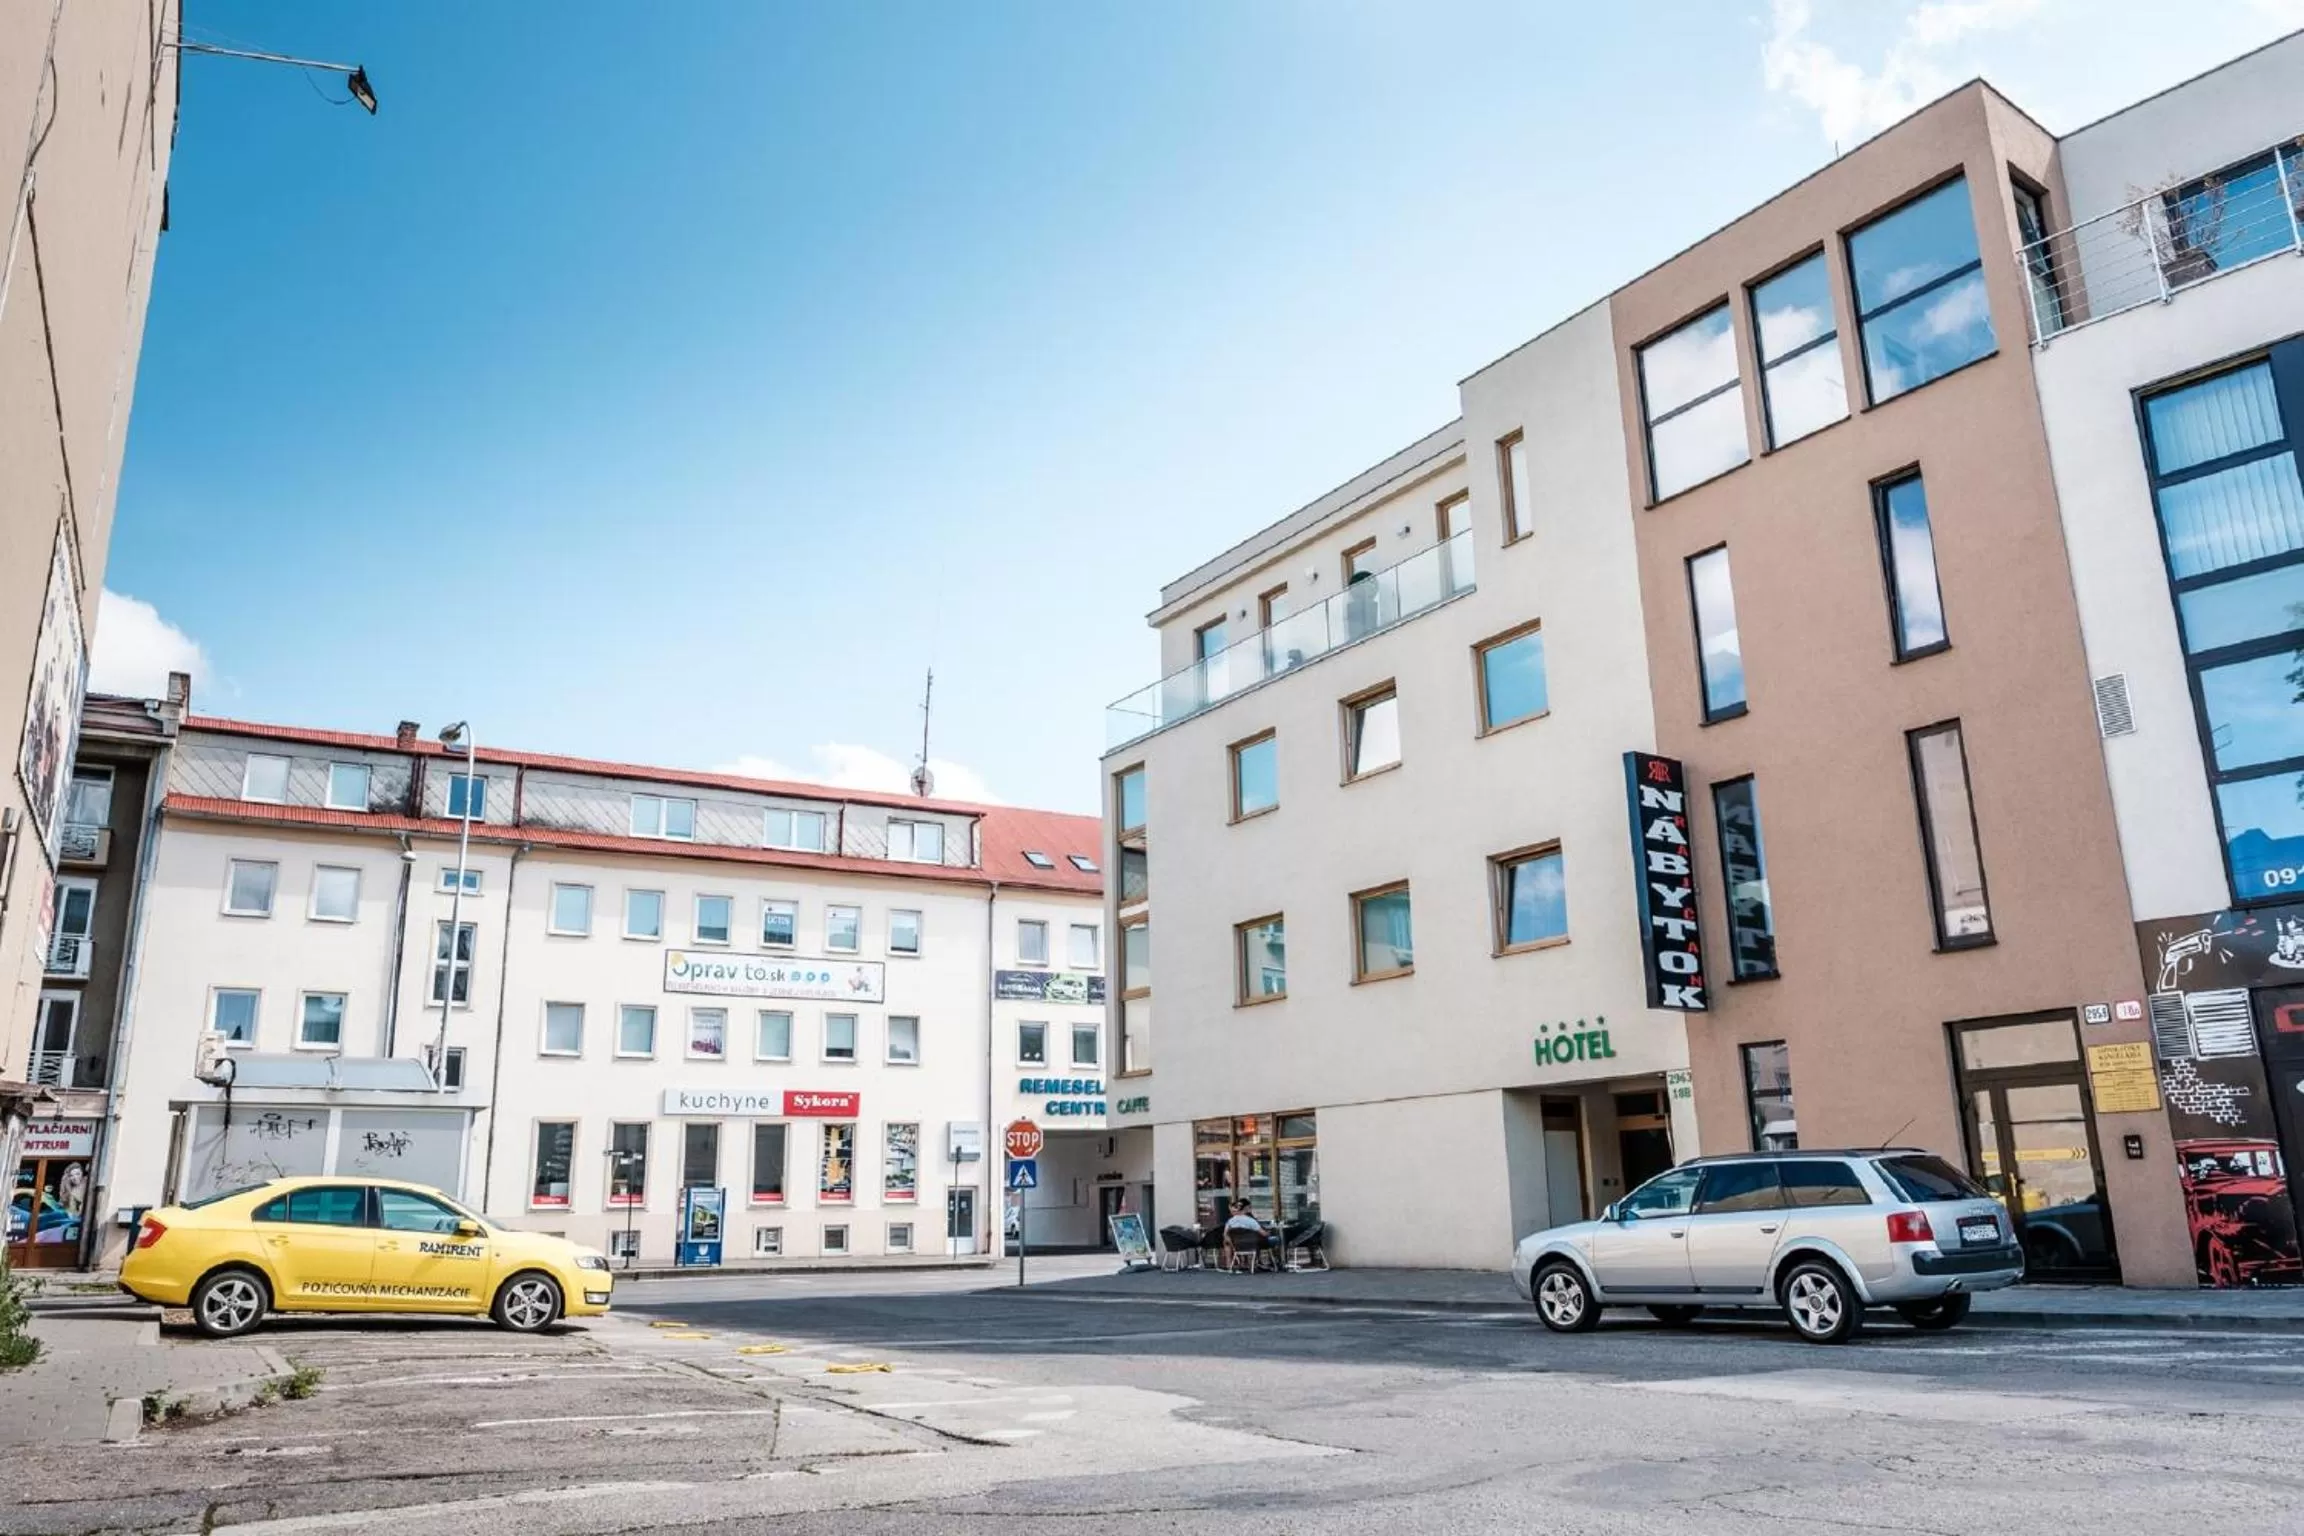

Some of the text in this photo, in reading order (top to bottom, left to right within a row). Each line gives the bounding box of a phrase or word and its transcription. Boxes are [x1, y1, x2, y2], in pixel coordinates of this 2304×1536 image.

[1640, 784, 1705, 1008] NÁBYTOK
[1535, 1030, 1617, 1067] HOTEL
[680, 1092, 769, 1112] kuchyne
[1007, 1132, 1038, 1147] STOP
[419, 1242, 484, 1257] RAMIRENT
